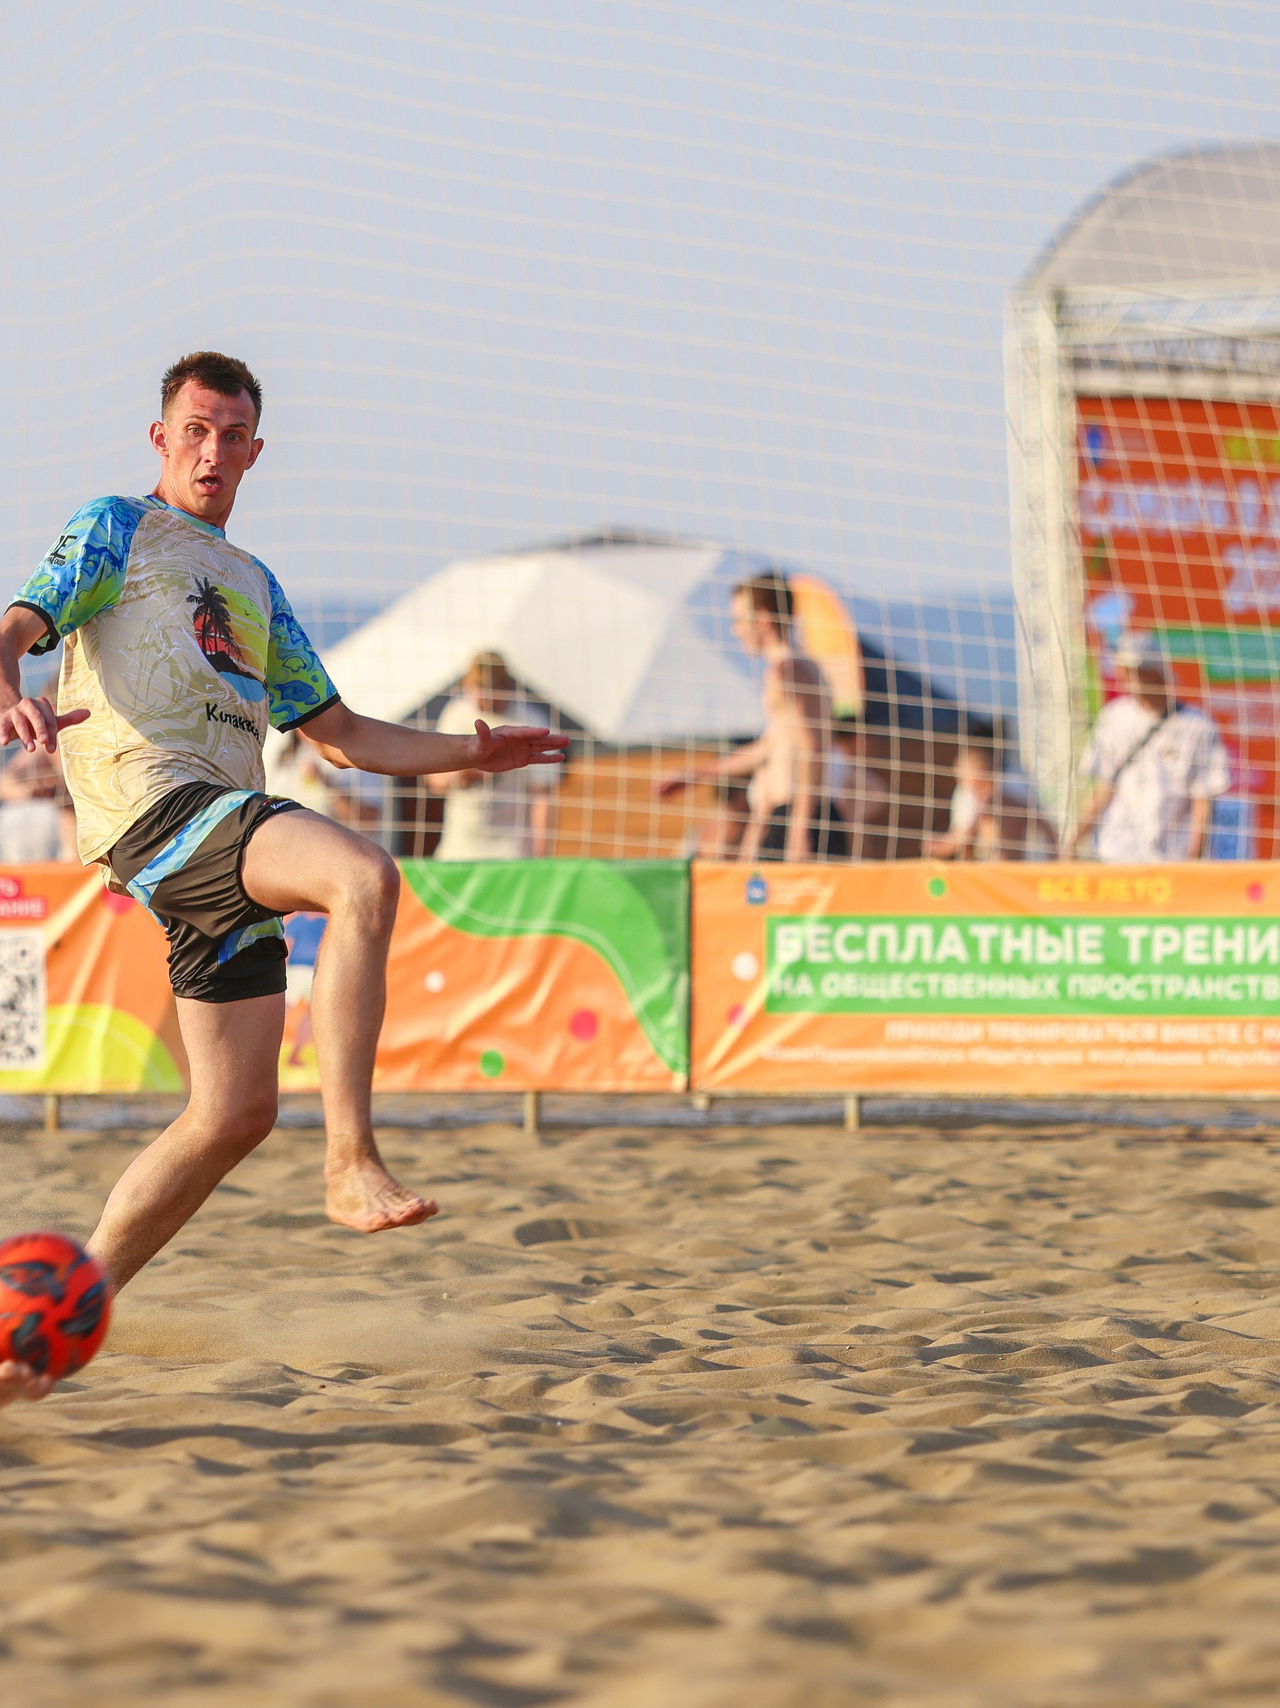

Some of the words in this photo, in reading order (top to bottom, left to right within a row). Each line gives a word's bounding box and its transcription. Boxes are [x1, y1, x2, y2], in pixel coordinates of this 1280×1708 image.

[776, 923, 1105, 965] БЕСПЛАТНЫЕ
[1119, 924, 1280, 965] ТРЕНИ
[774, 972, 816, 999] НА
[821, 972, 1062, 1002] ОБЩЕСТВЕННЫХ
[1067, 972, 1280, 1001] ПРОСТРАНСТВ
